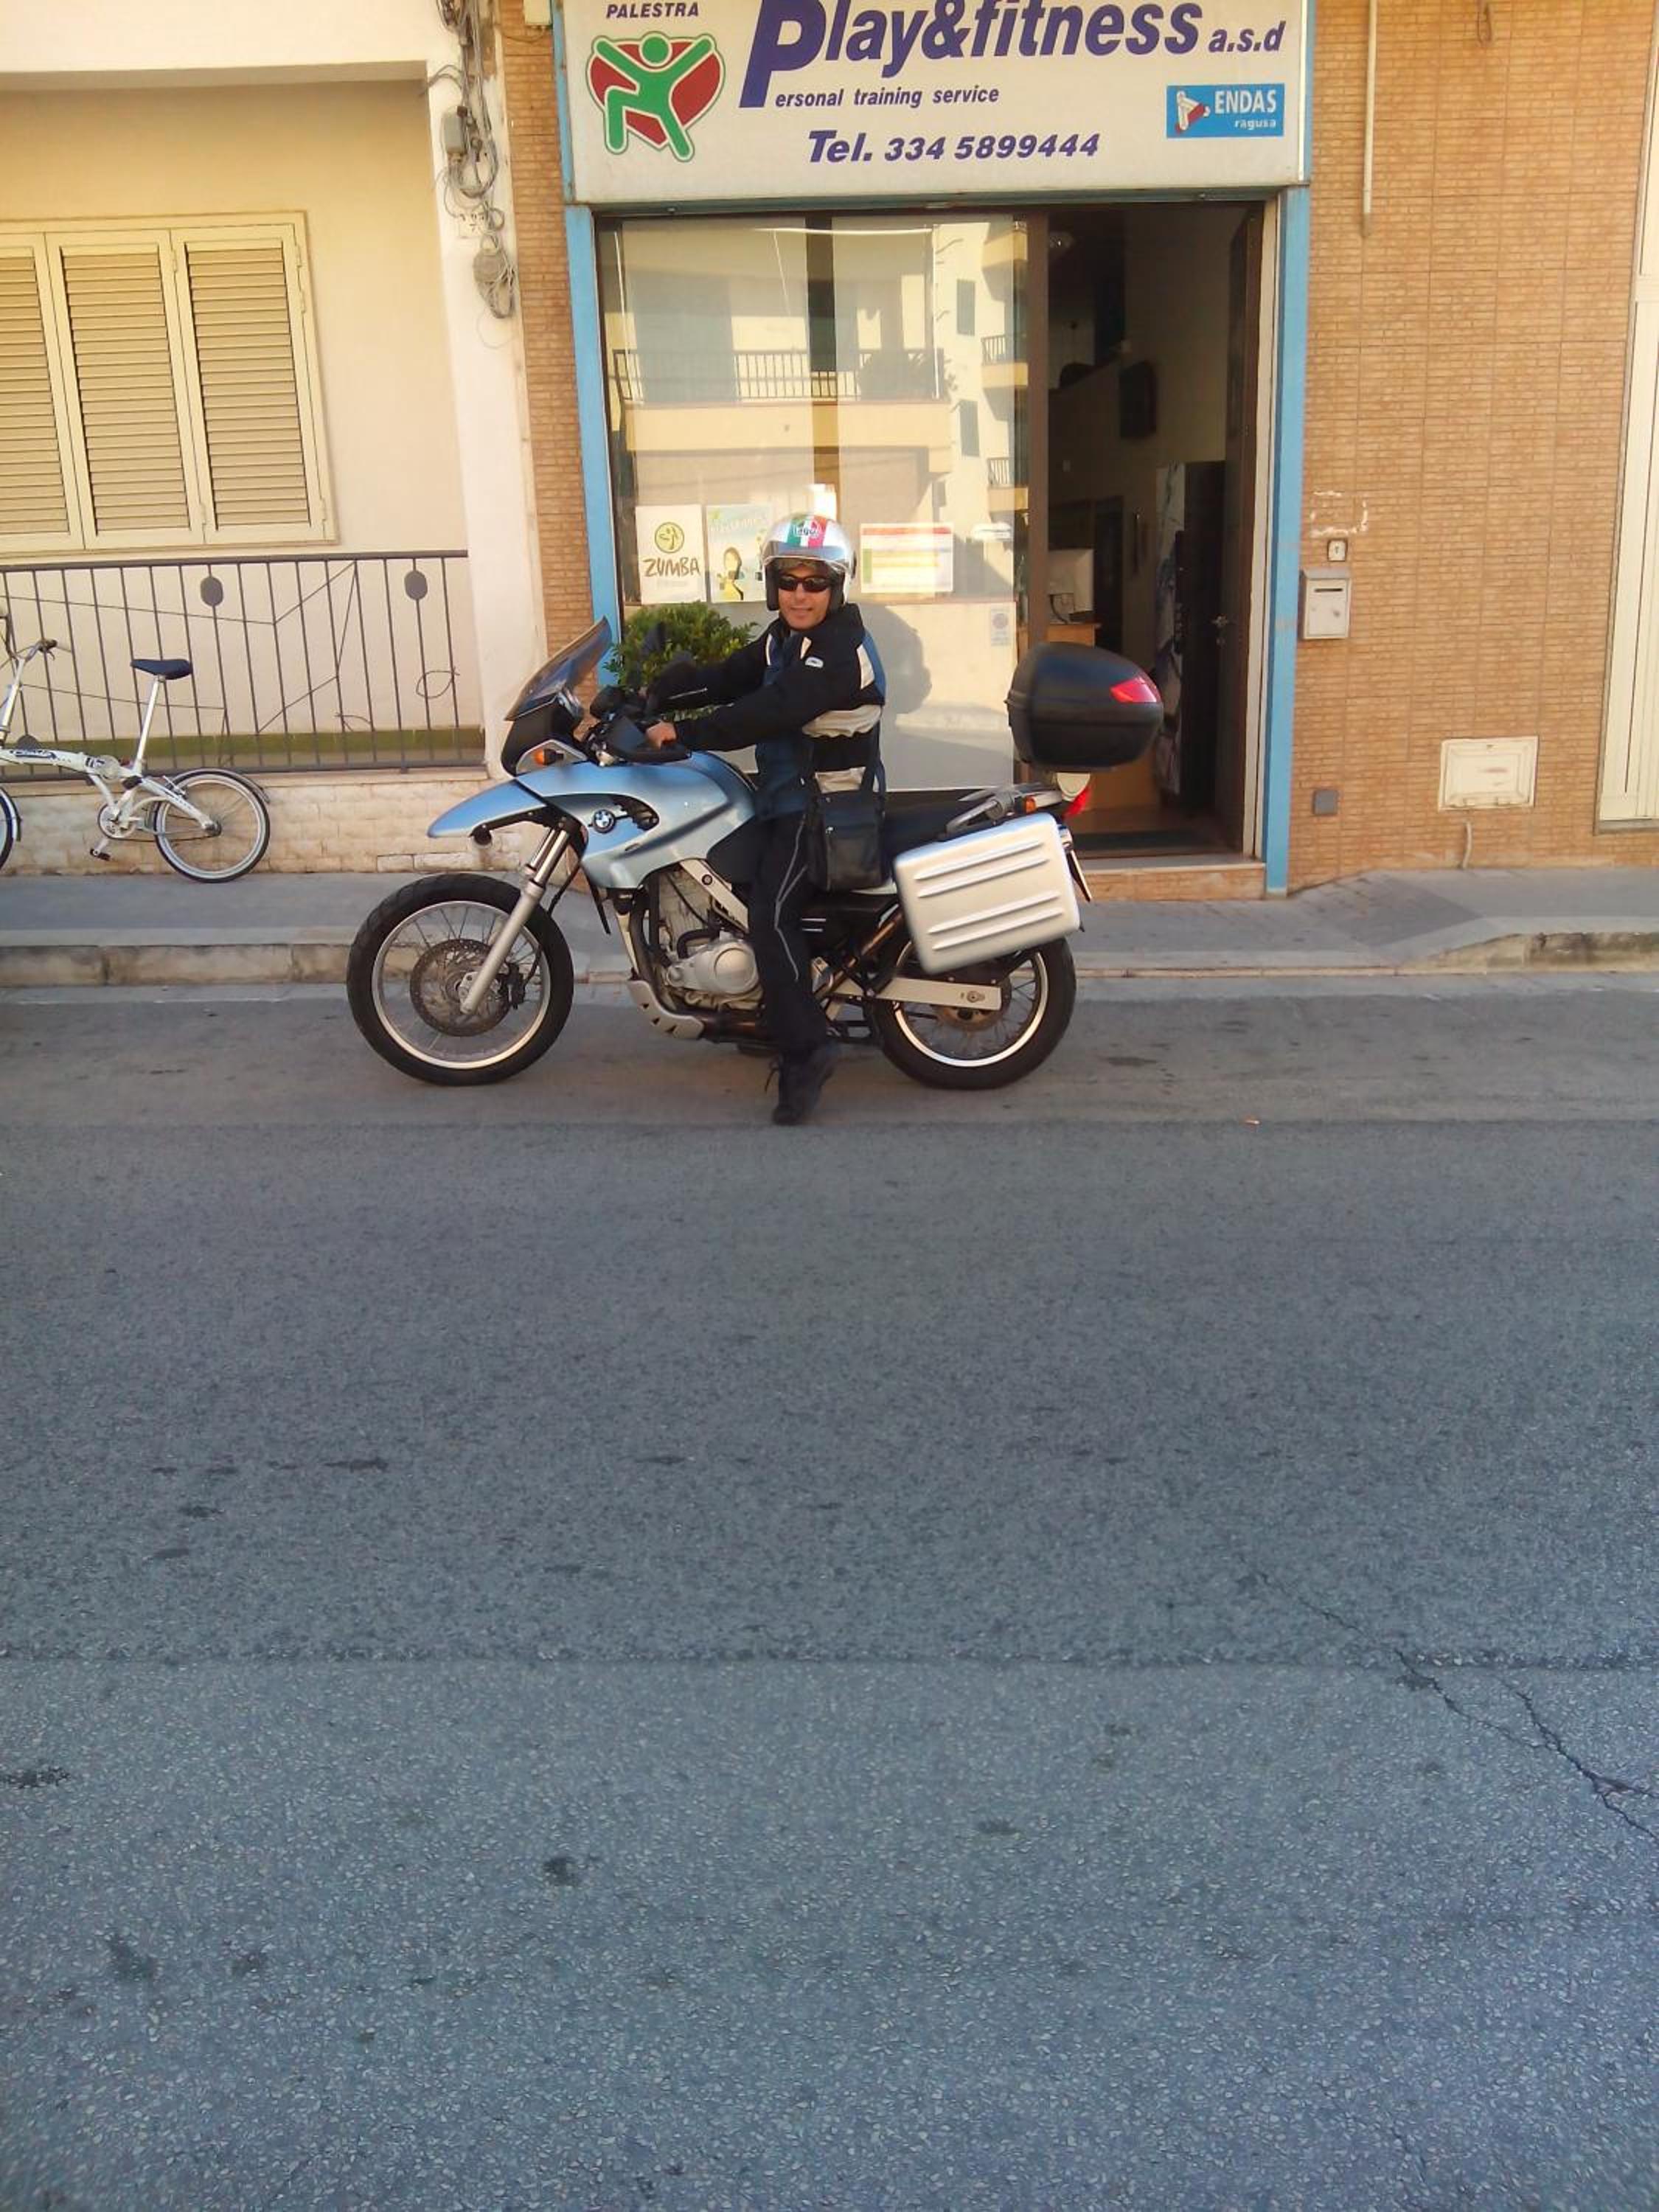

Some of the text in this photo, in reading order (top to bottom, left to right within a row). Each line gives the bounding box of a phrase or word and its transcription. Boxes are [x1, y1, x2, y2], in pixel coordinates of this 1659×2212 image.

[606, 2, 699, 18] PALESTRA
[1208, 21, 1287, 52] a.s.d
[854, 86, 922, 108] training
[932, 85, 999, 104] service
[1214, 90, 1277, 114] ENDAS
[1235, 119, 1276, 131] ragusa
[808, 130, 1100, 163] Tel. 334 5899444
[642, 557, 700, 577] ZUMBA
